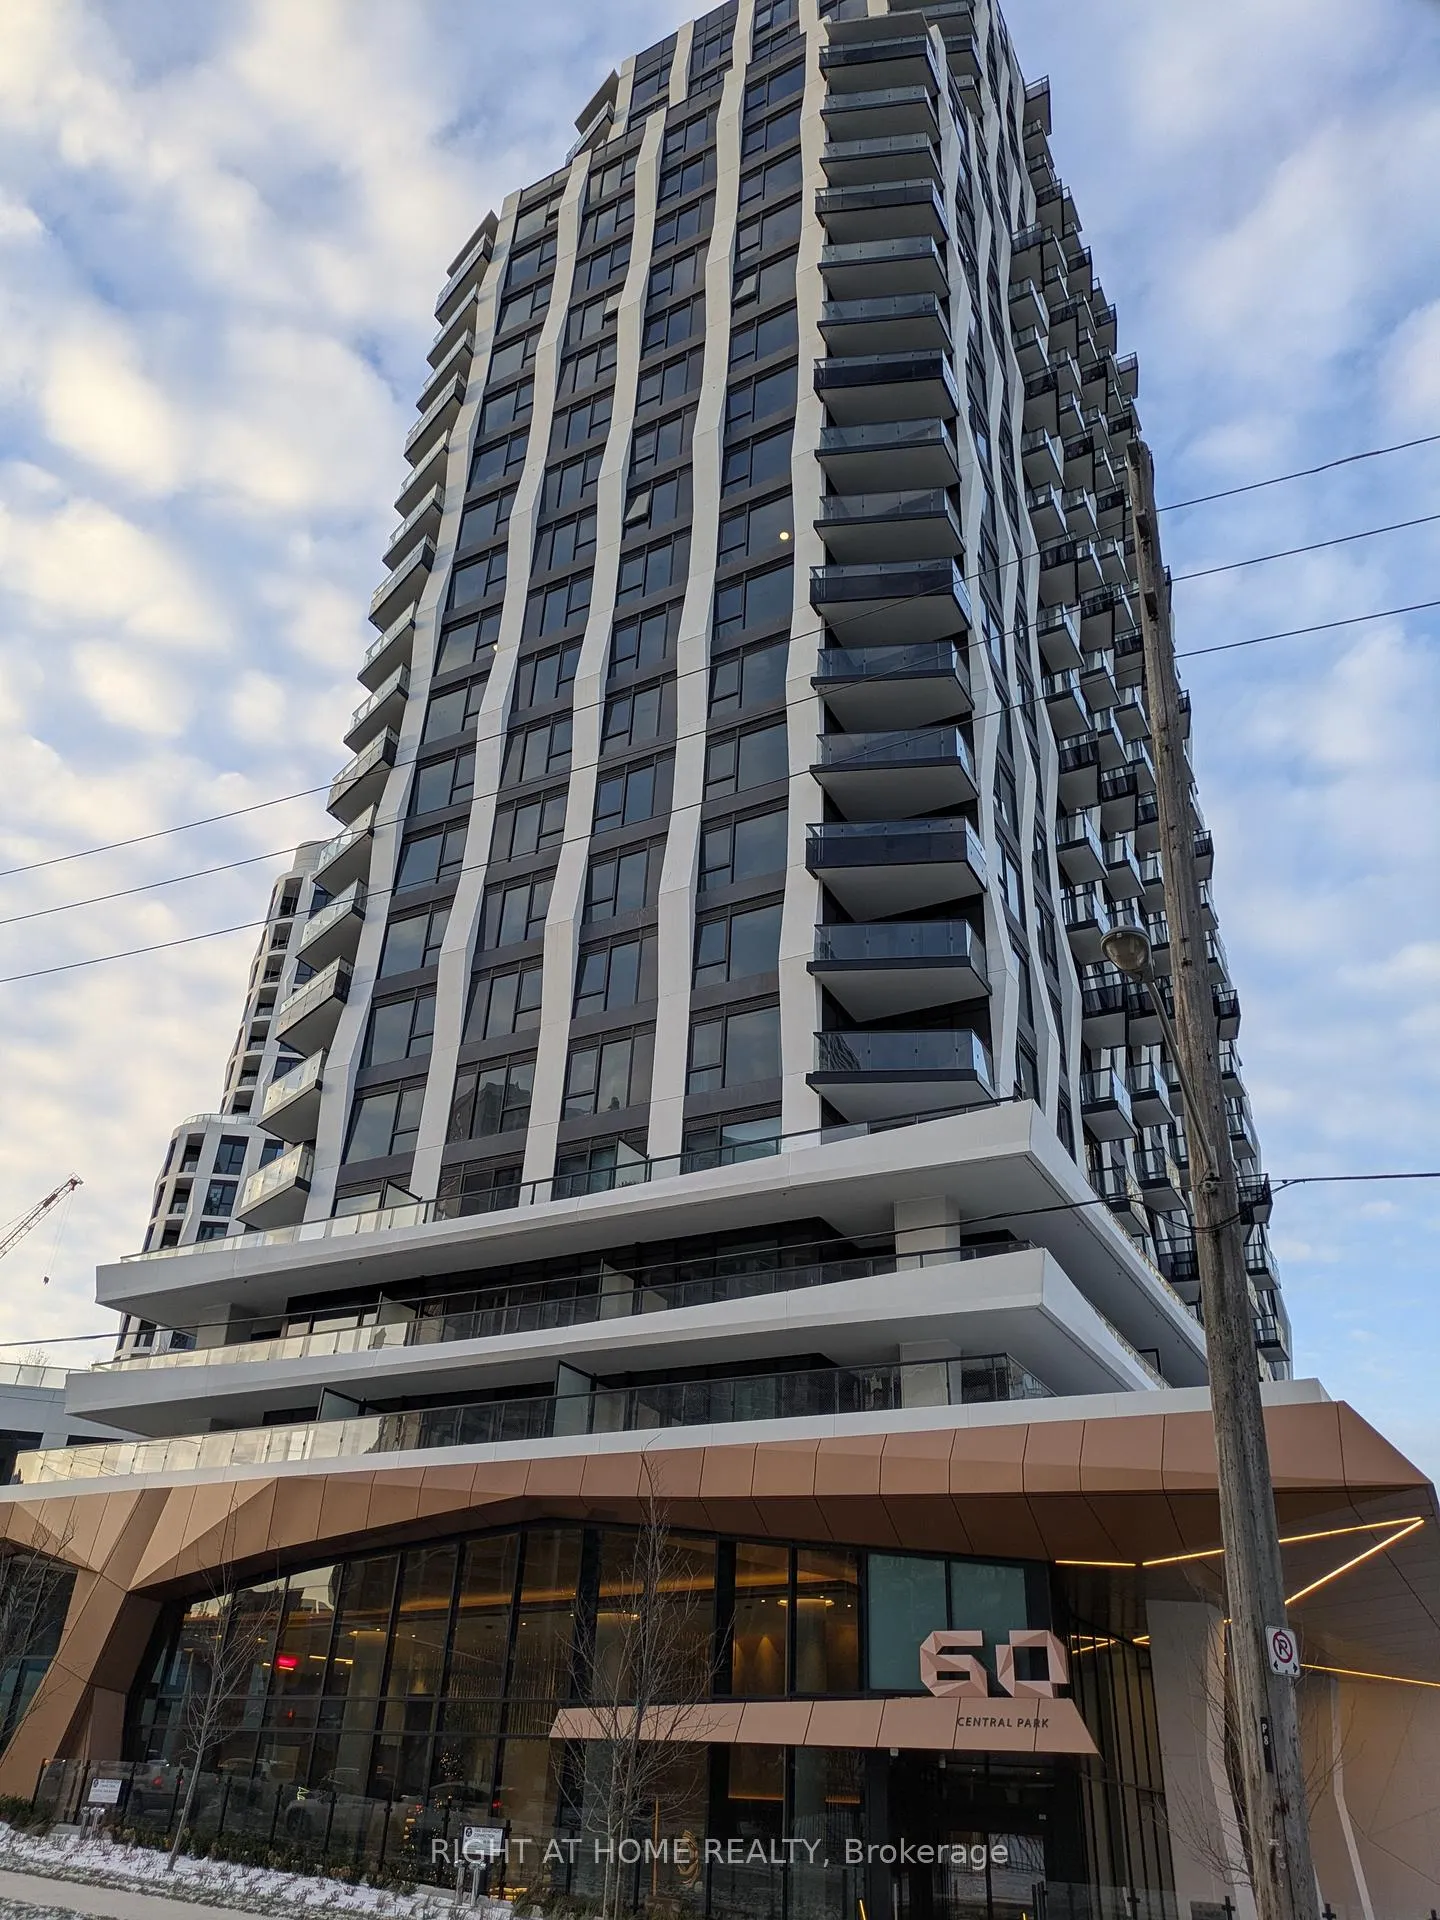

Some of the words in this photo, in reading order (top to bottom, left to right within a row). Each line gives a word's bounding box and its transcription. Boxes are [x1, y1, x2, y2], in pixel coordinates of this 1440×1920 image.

[920, 1630, 1070, 1698] 60
[957, 1717, 1012, 1728] CENTRAL
[1017, 1718, 1049, 1728] PARK
